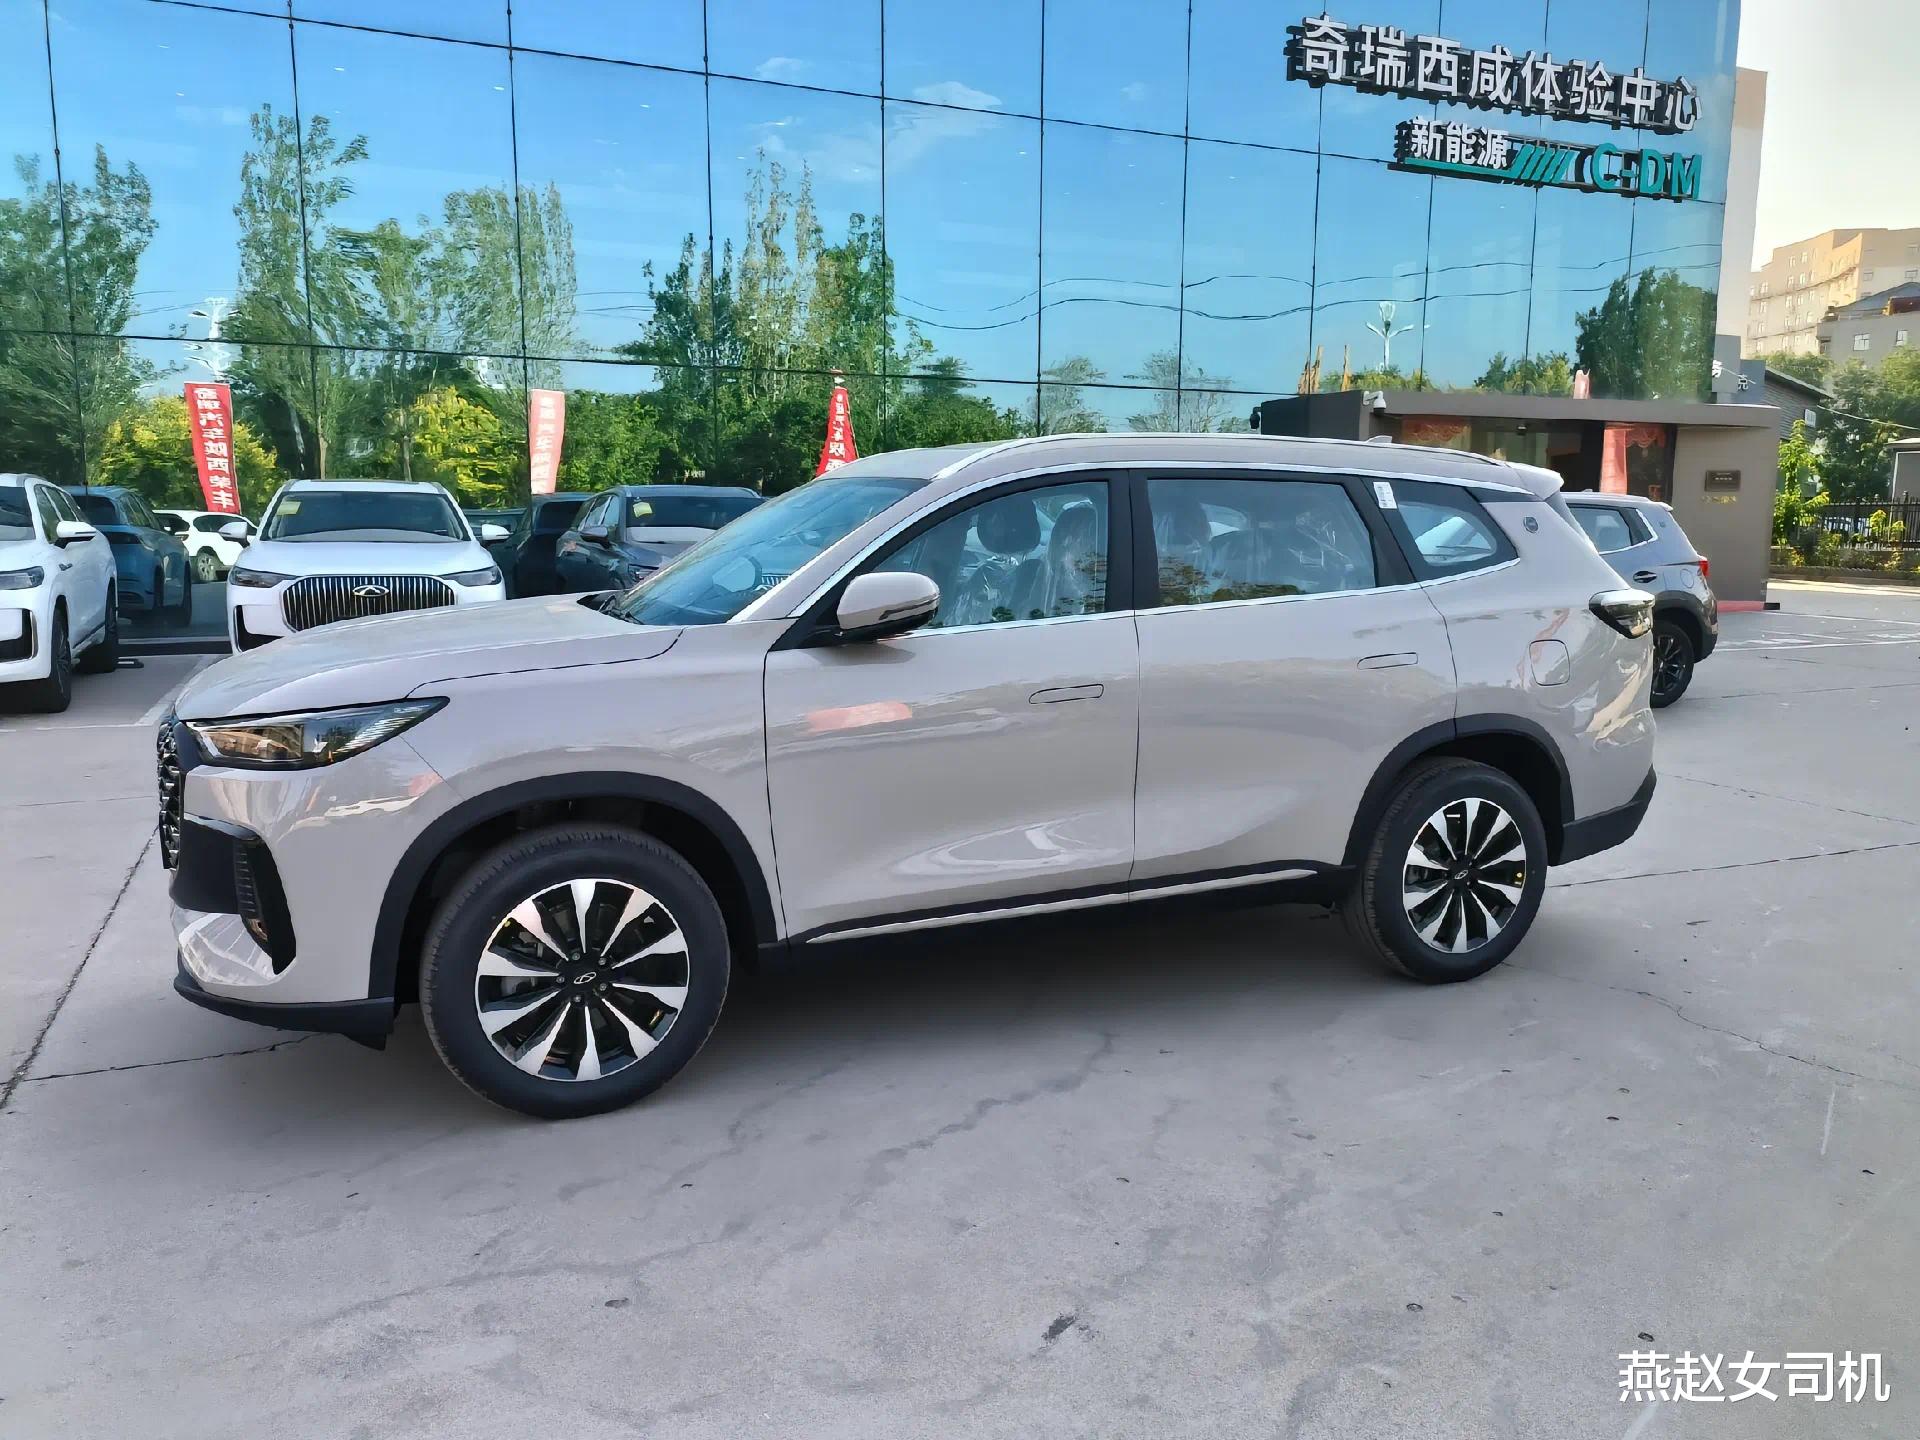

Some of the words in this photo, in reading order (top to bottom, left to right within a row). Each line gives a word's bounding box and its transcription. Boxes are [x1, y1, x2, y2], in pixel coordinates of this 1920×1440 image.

[1302, 15, 1703, 131] 奇瑞西咸体验中心
[1410, 117, 1509, 170] 新能源
